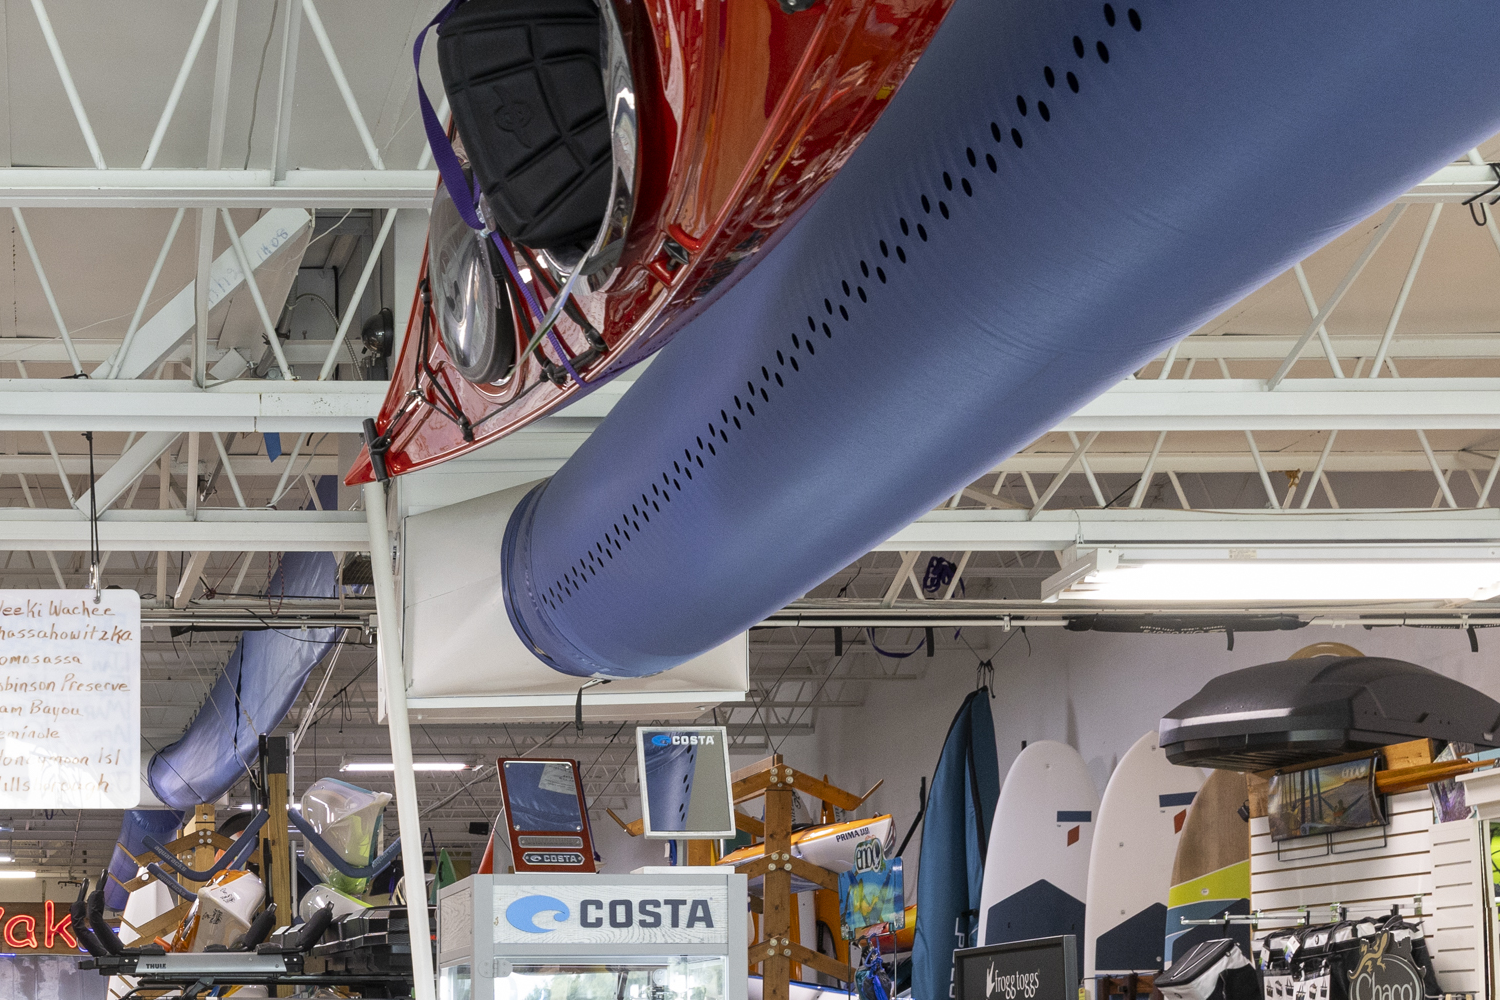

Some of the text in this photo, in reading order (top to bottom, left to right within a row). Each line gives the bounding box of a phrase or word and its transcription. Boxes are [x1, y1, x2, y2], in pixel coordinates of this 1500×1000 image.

[49, 599, 115, 618] Wachee
[60, 672, 130, 693] Preserve
[29, 700, 84, 722] Bayou
[672, 736, 714, 745] COSTA
[836, 829, 860, 843] PRIMA
[154, 845, 188, 872] aquaracks
[156, 871, 186, 897] aquaracks
[580, 898, 714, 928] COSTA
[995, 970, 1039, 1000] frogg toggs
